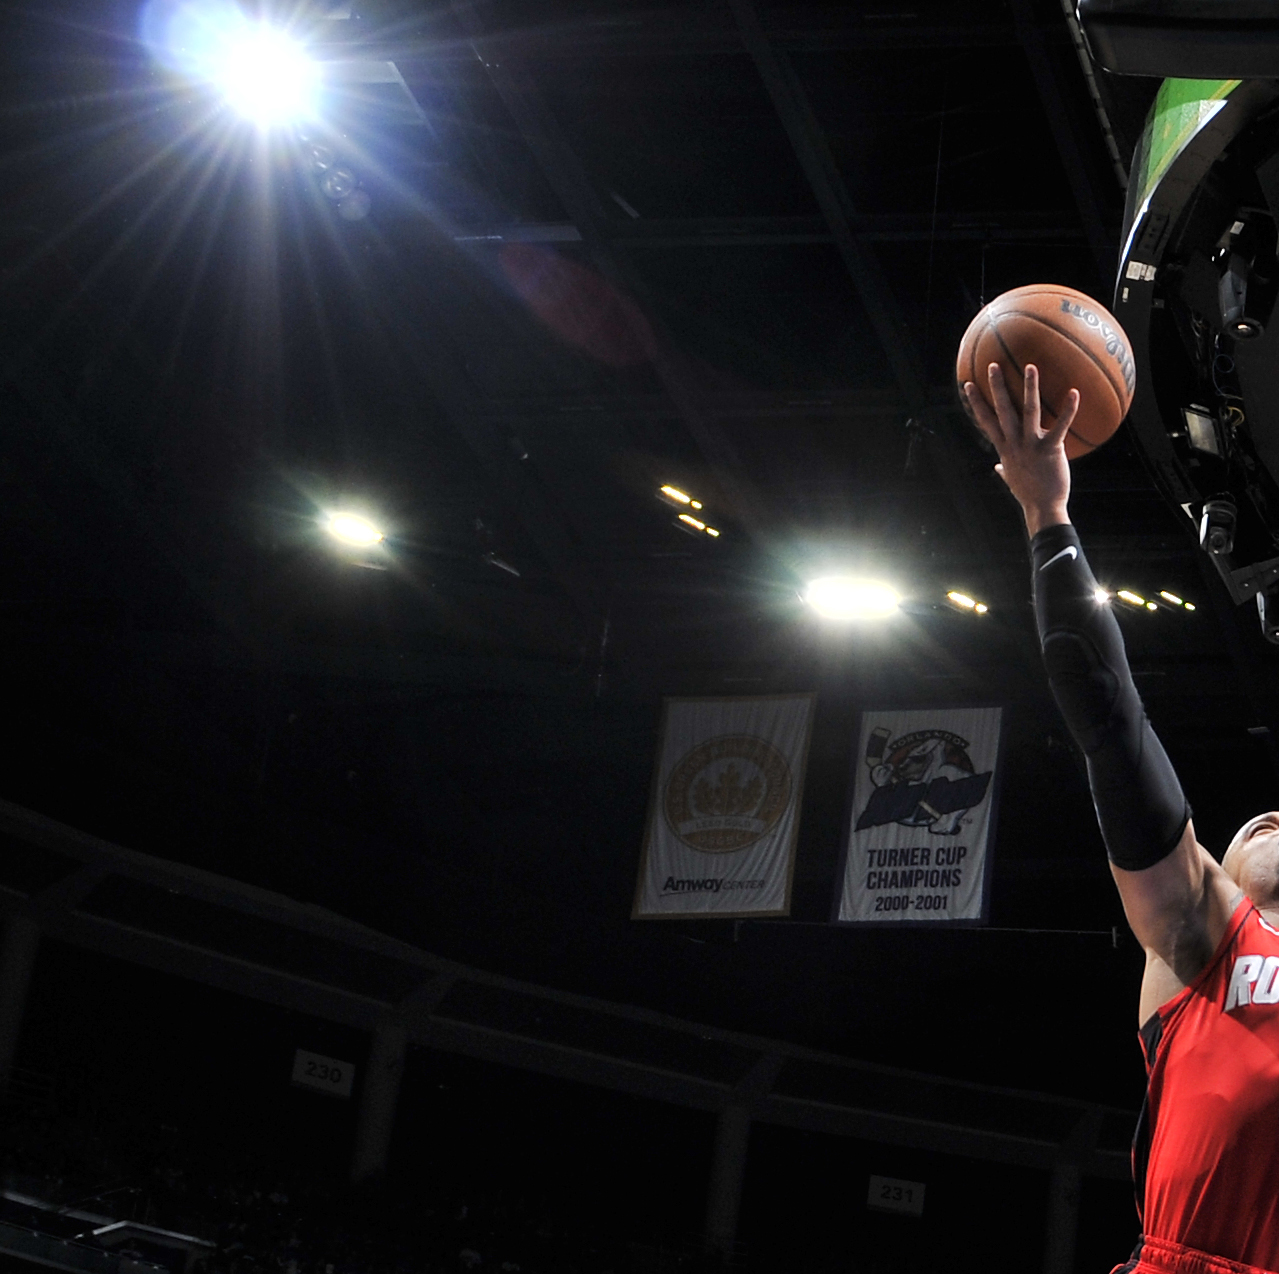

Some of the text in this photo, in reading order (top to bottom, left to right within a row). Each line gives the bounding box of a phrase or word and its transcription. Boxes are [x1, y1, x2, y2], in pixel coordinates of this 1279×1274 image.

[867, 846, 967, 868] TURNER CUP
[663, 876, 766, 893] Amway CENTER
[866, 868, 961, 890] CHAMPIONS
[875, 896, 948, 912] 2000-2001
[305, 1061, 342, 1084] 230
[880, 1185, 913, 1203] 231
